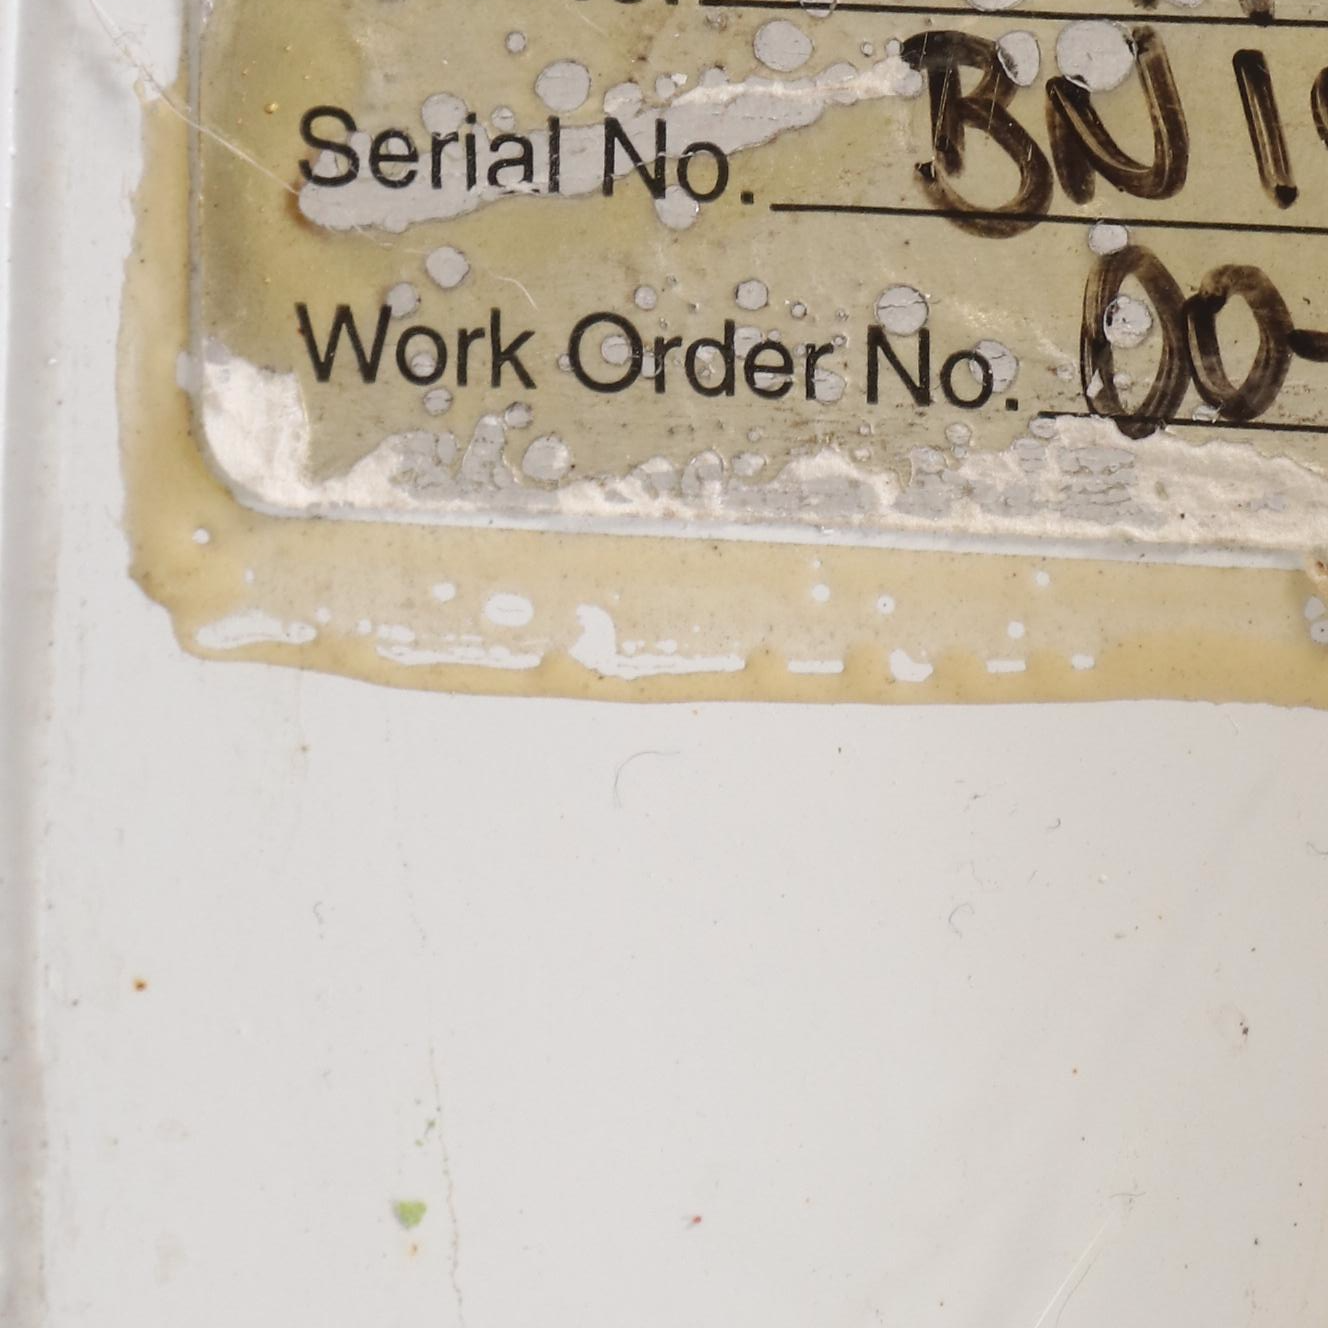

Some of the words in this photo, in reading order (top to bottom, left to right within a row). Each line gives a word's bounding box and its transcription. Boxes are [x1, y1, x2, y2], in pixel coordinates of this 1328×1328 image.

[298, 106, 560, 196] Serial
[603, 117, 756, 205] No.
[294, 302, 537, 391] Work
[567, 310, 836, 400] Order
[866, 322, 1020, 413] No.
